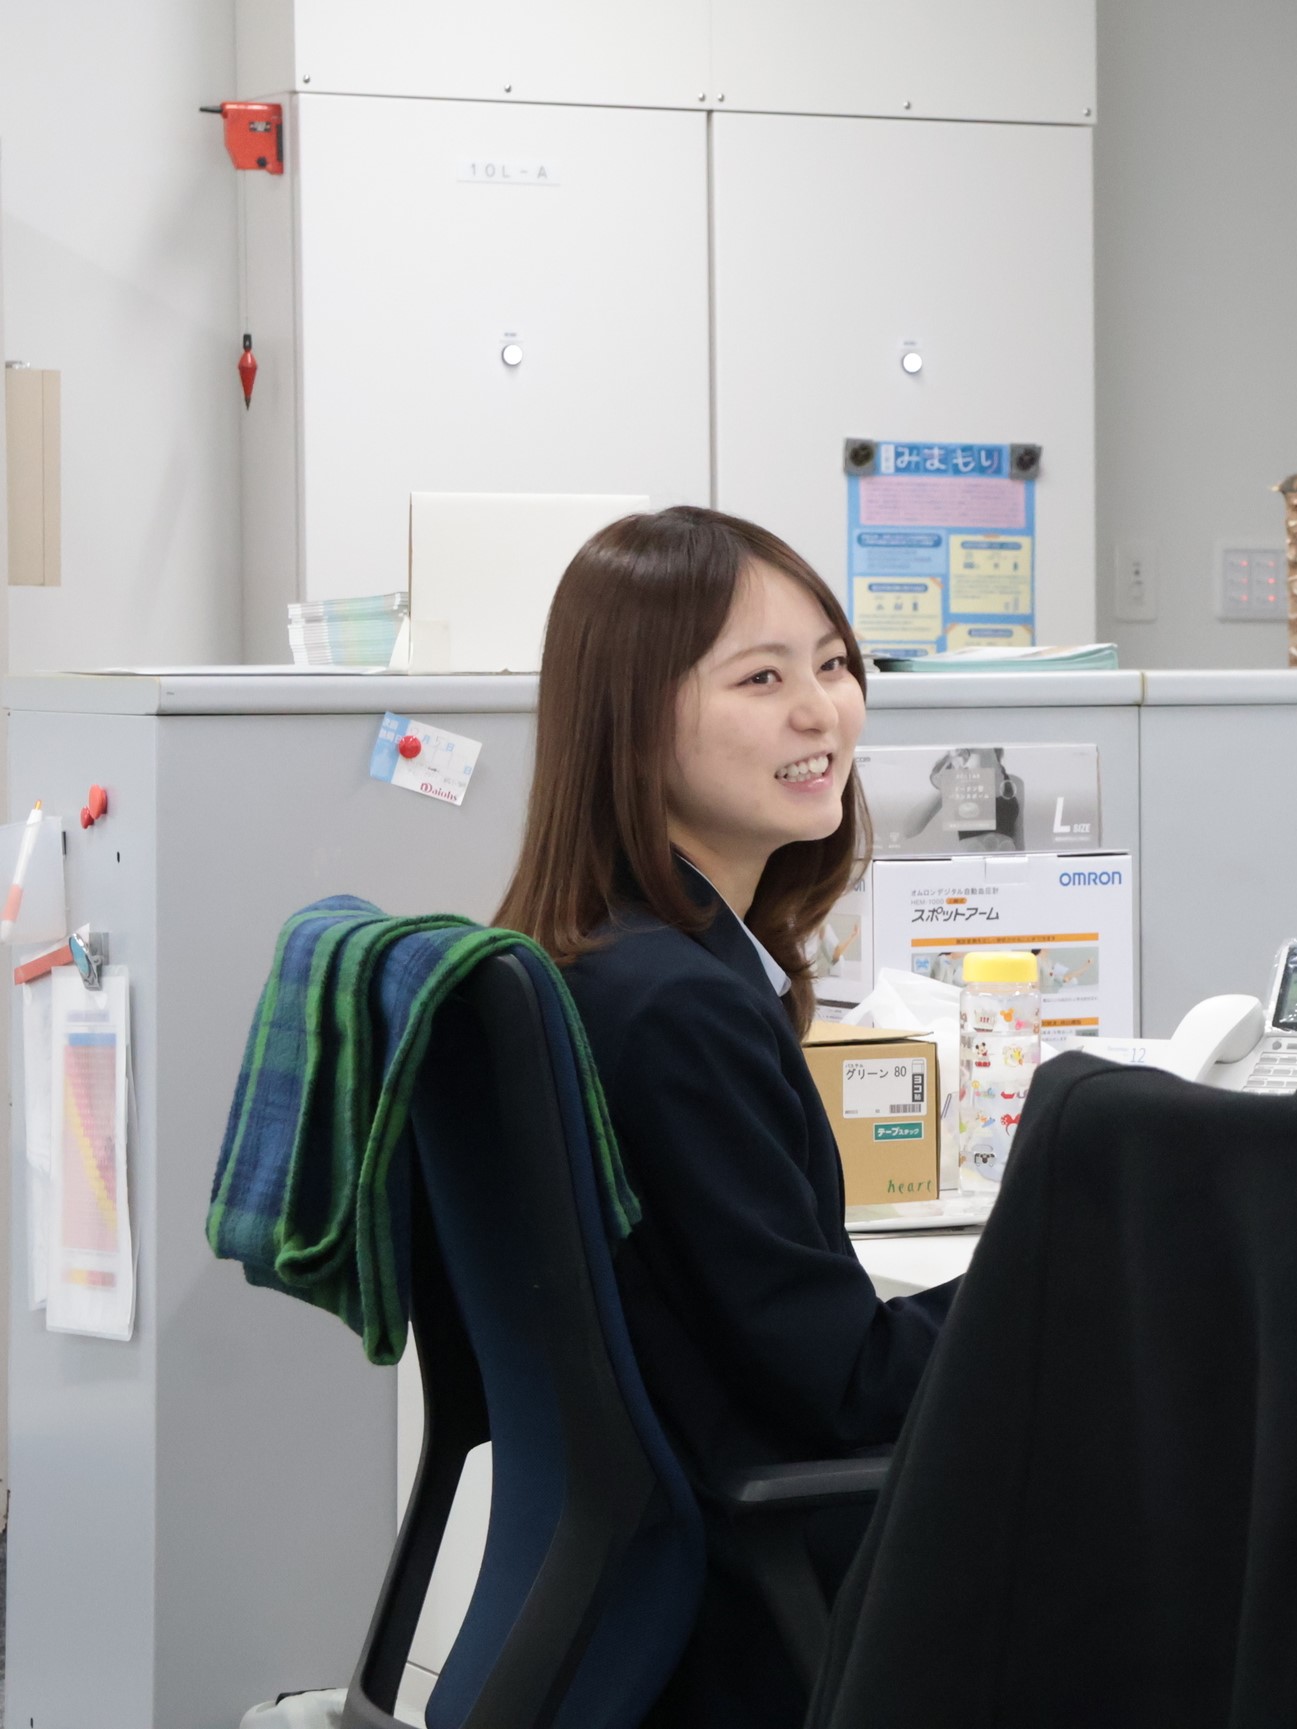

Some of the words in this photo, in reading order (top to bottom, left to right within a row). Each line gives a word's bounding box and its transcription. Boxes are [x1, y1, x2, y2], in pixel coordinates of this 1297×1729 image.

[896, 446, 998, 473] みまもり
[1053, 797, 1071, 833] L
[1073, 823, 1091, 833] SIZE
[1059, 871, 1122, 887] OMRON
[911, 906, 999, 923] スポットアーム
[1131, 1047, 1146, 1063] 12
[846, 1068, 889, 1080] グリーン
[894, 1065, 907, 1078] 80
[887, 1179, 932, 1194] heart
